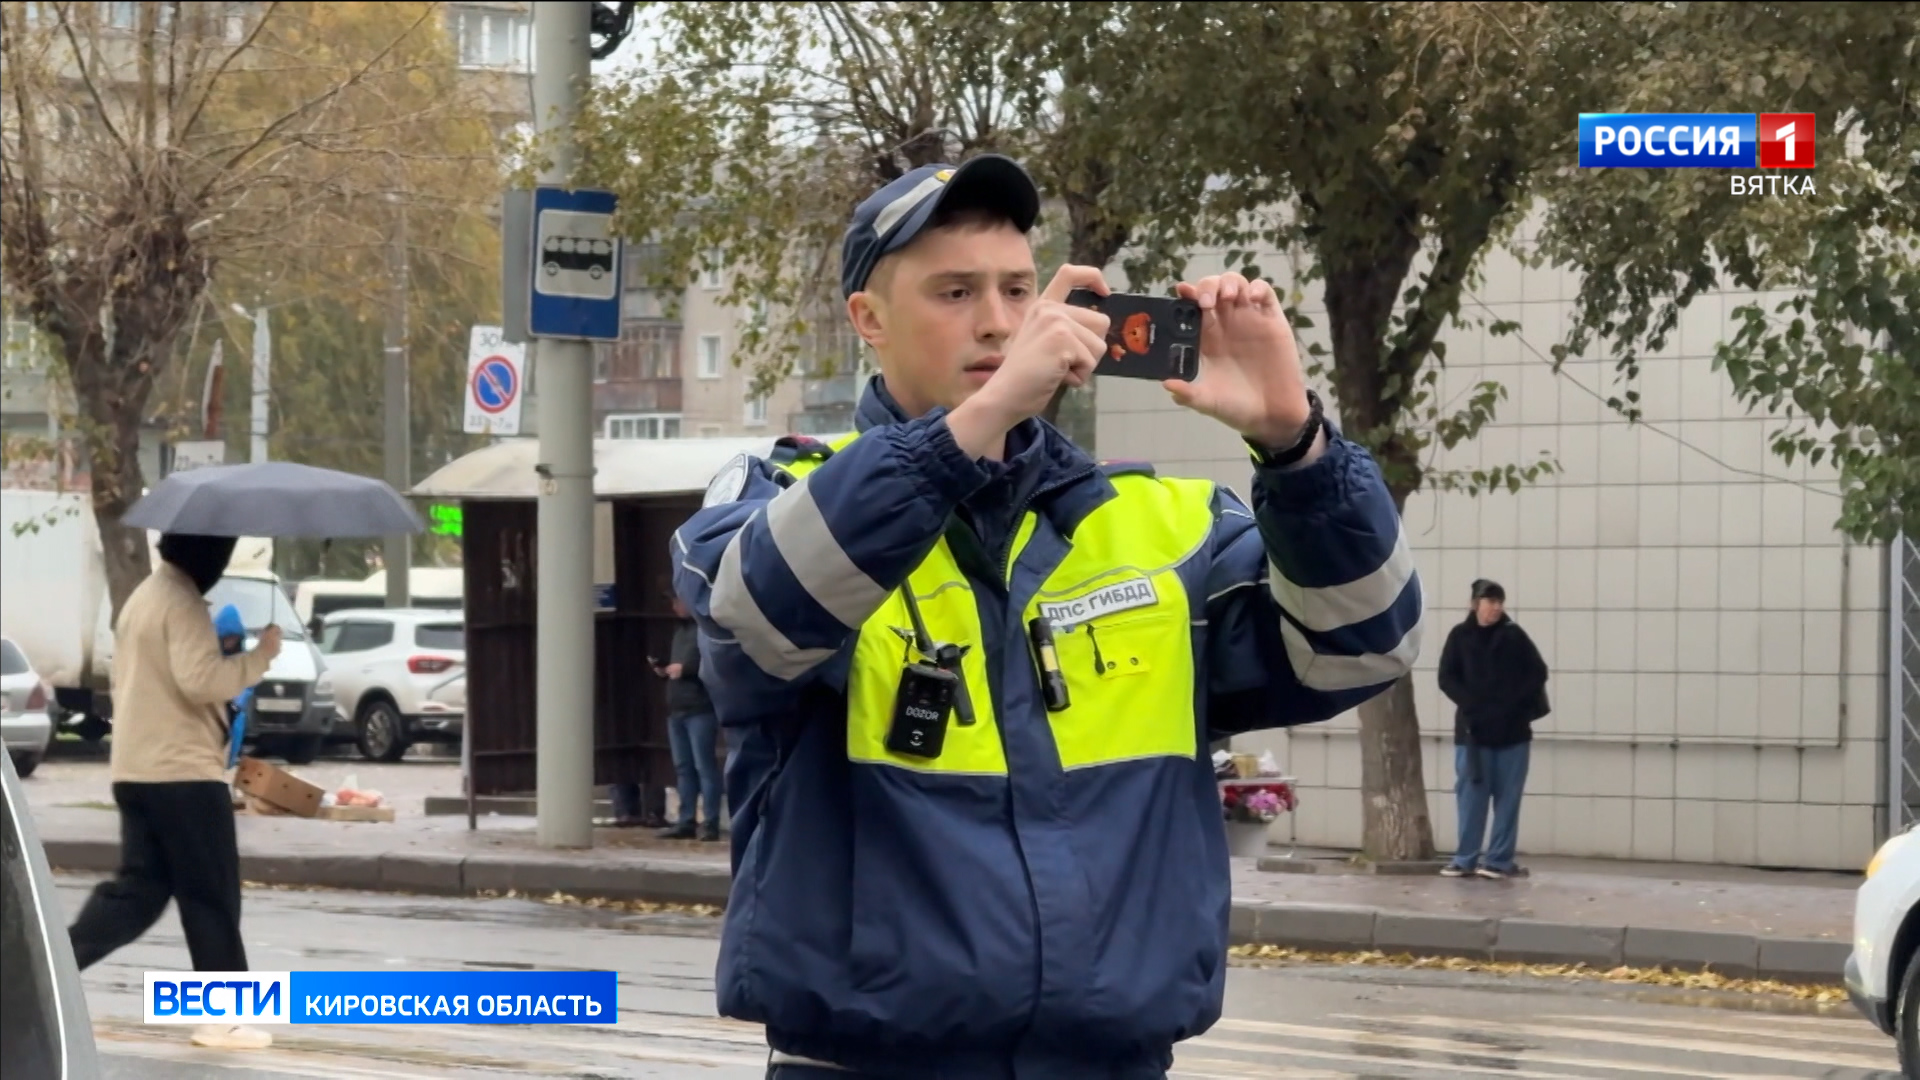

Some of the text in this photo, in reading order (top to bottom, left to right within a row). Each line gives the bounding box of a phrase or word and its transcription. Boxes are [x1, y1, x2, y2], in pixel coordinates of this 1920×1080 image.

[1047, 583, 1152, 621] ДПС ГИБДД
[905, 705, 939, 721] DOZOR
